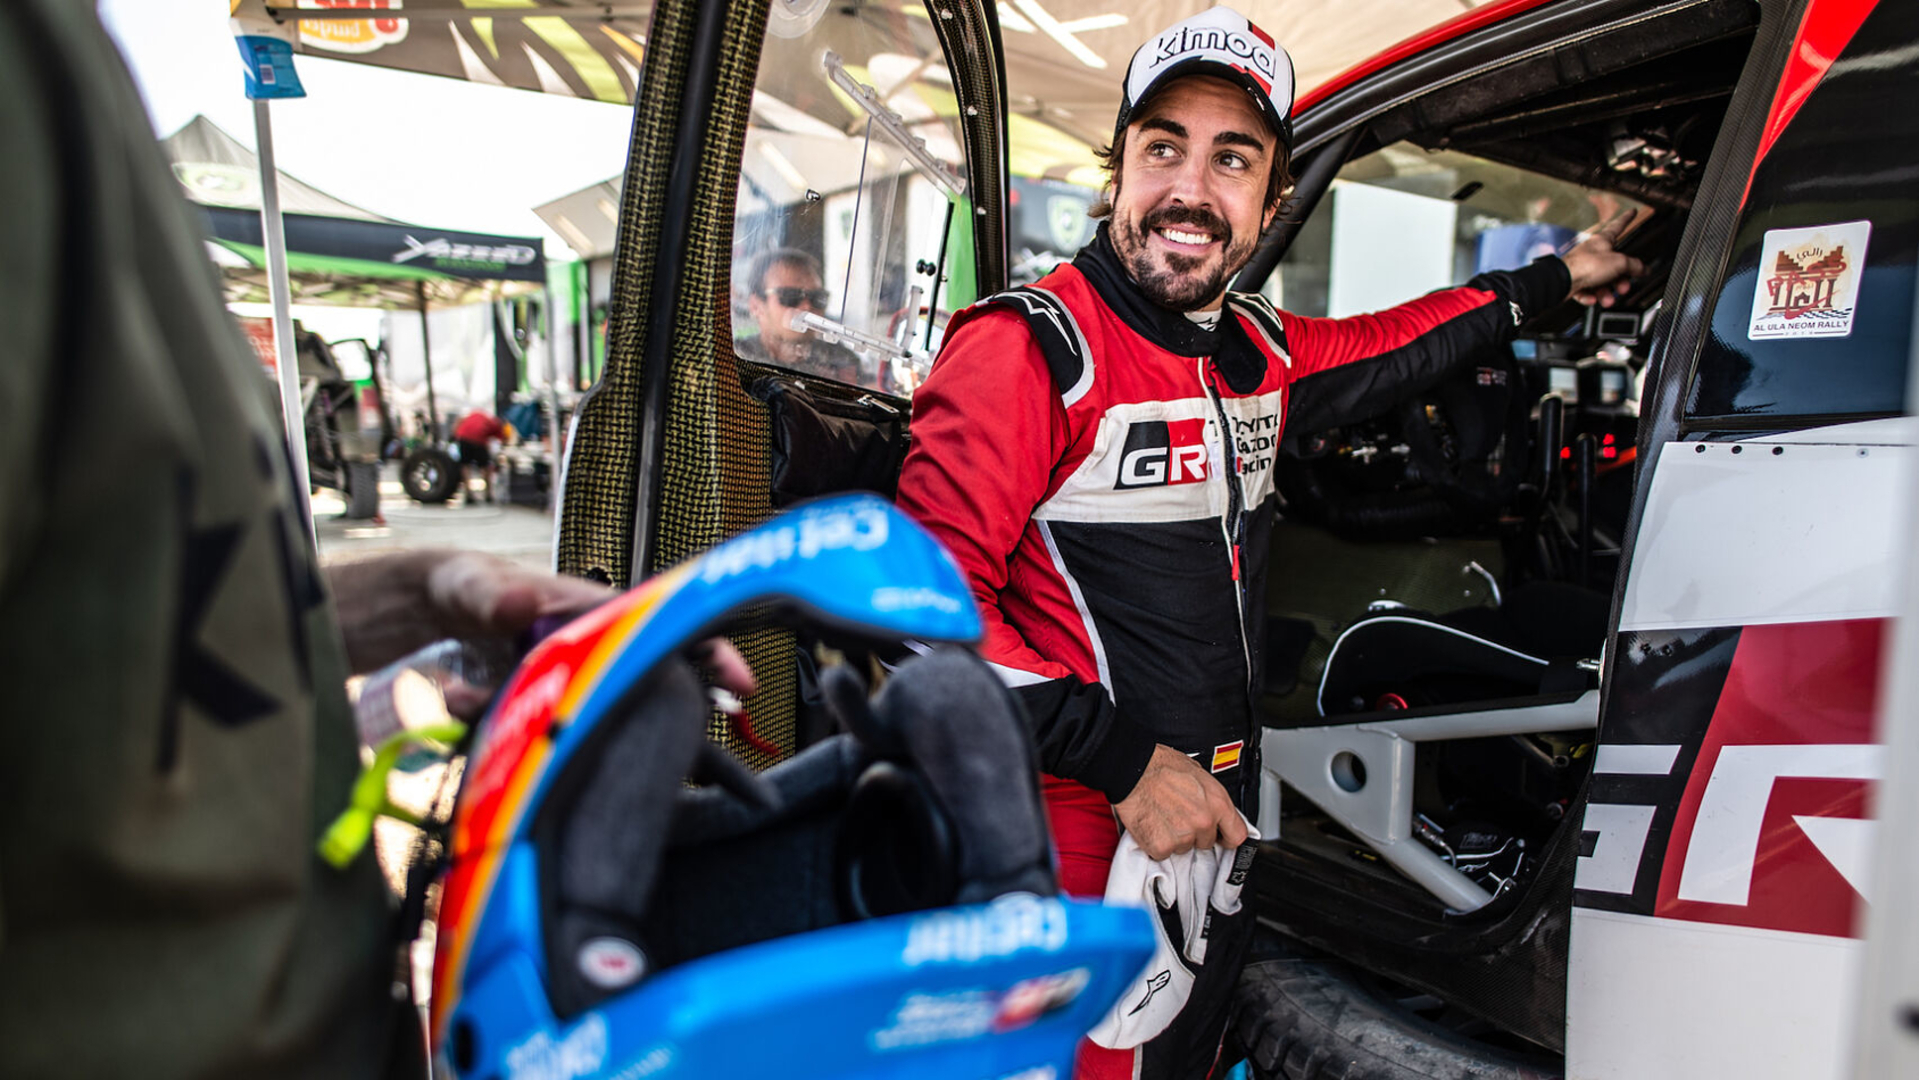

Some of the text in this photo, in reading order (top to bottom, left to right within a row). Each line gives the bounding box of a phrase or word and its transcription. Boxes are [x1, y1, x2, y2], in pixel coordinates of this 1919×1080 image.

[1149, 27, 1276, 80] kimoa
[1767, 323, 1785, 331] ULA
[1787, 321, 1815, 330] NEOM
[1818, 320, 1848, 329] RALLY
[1120, 443, 1208, 486] GR
